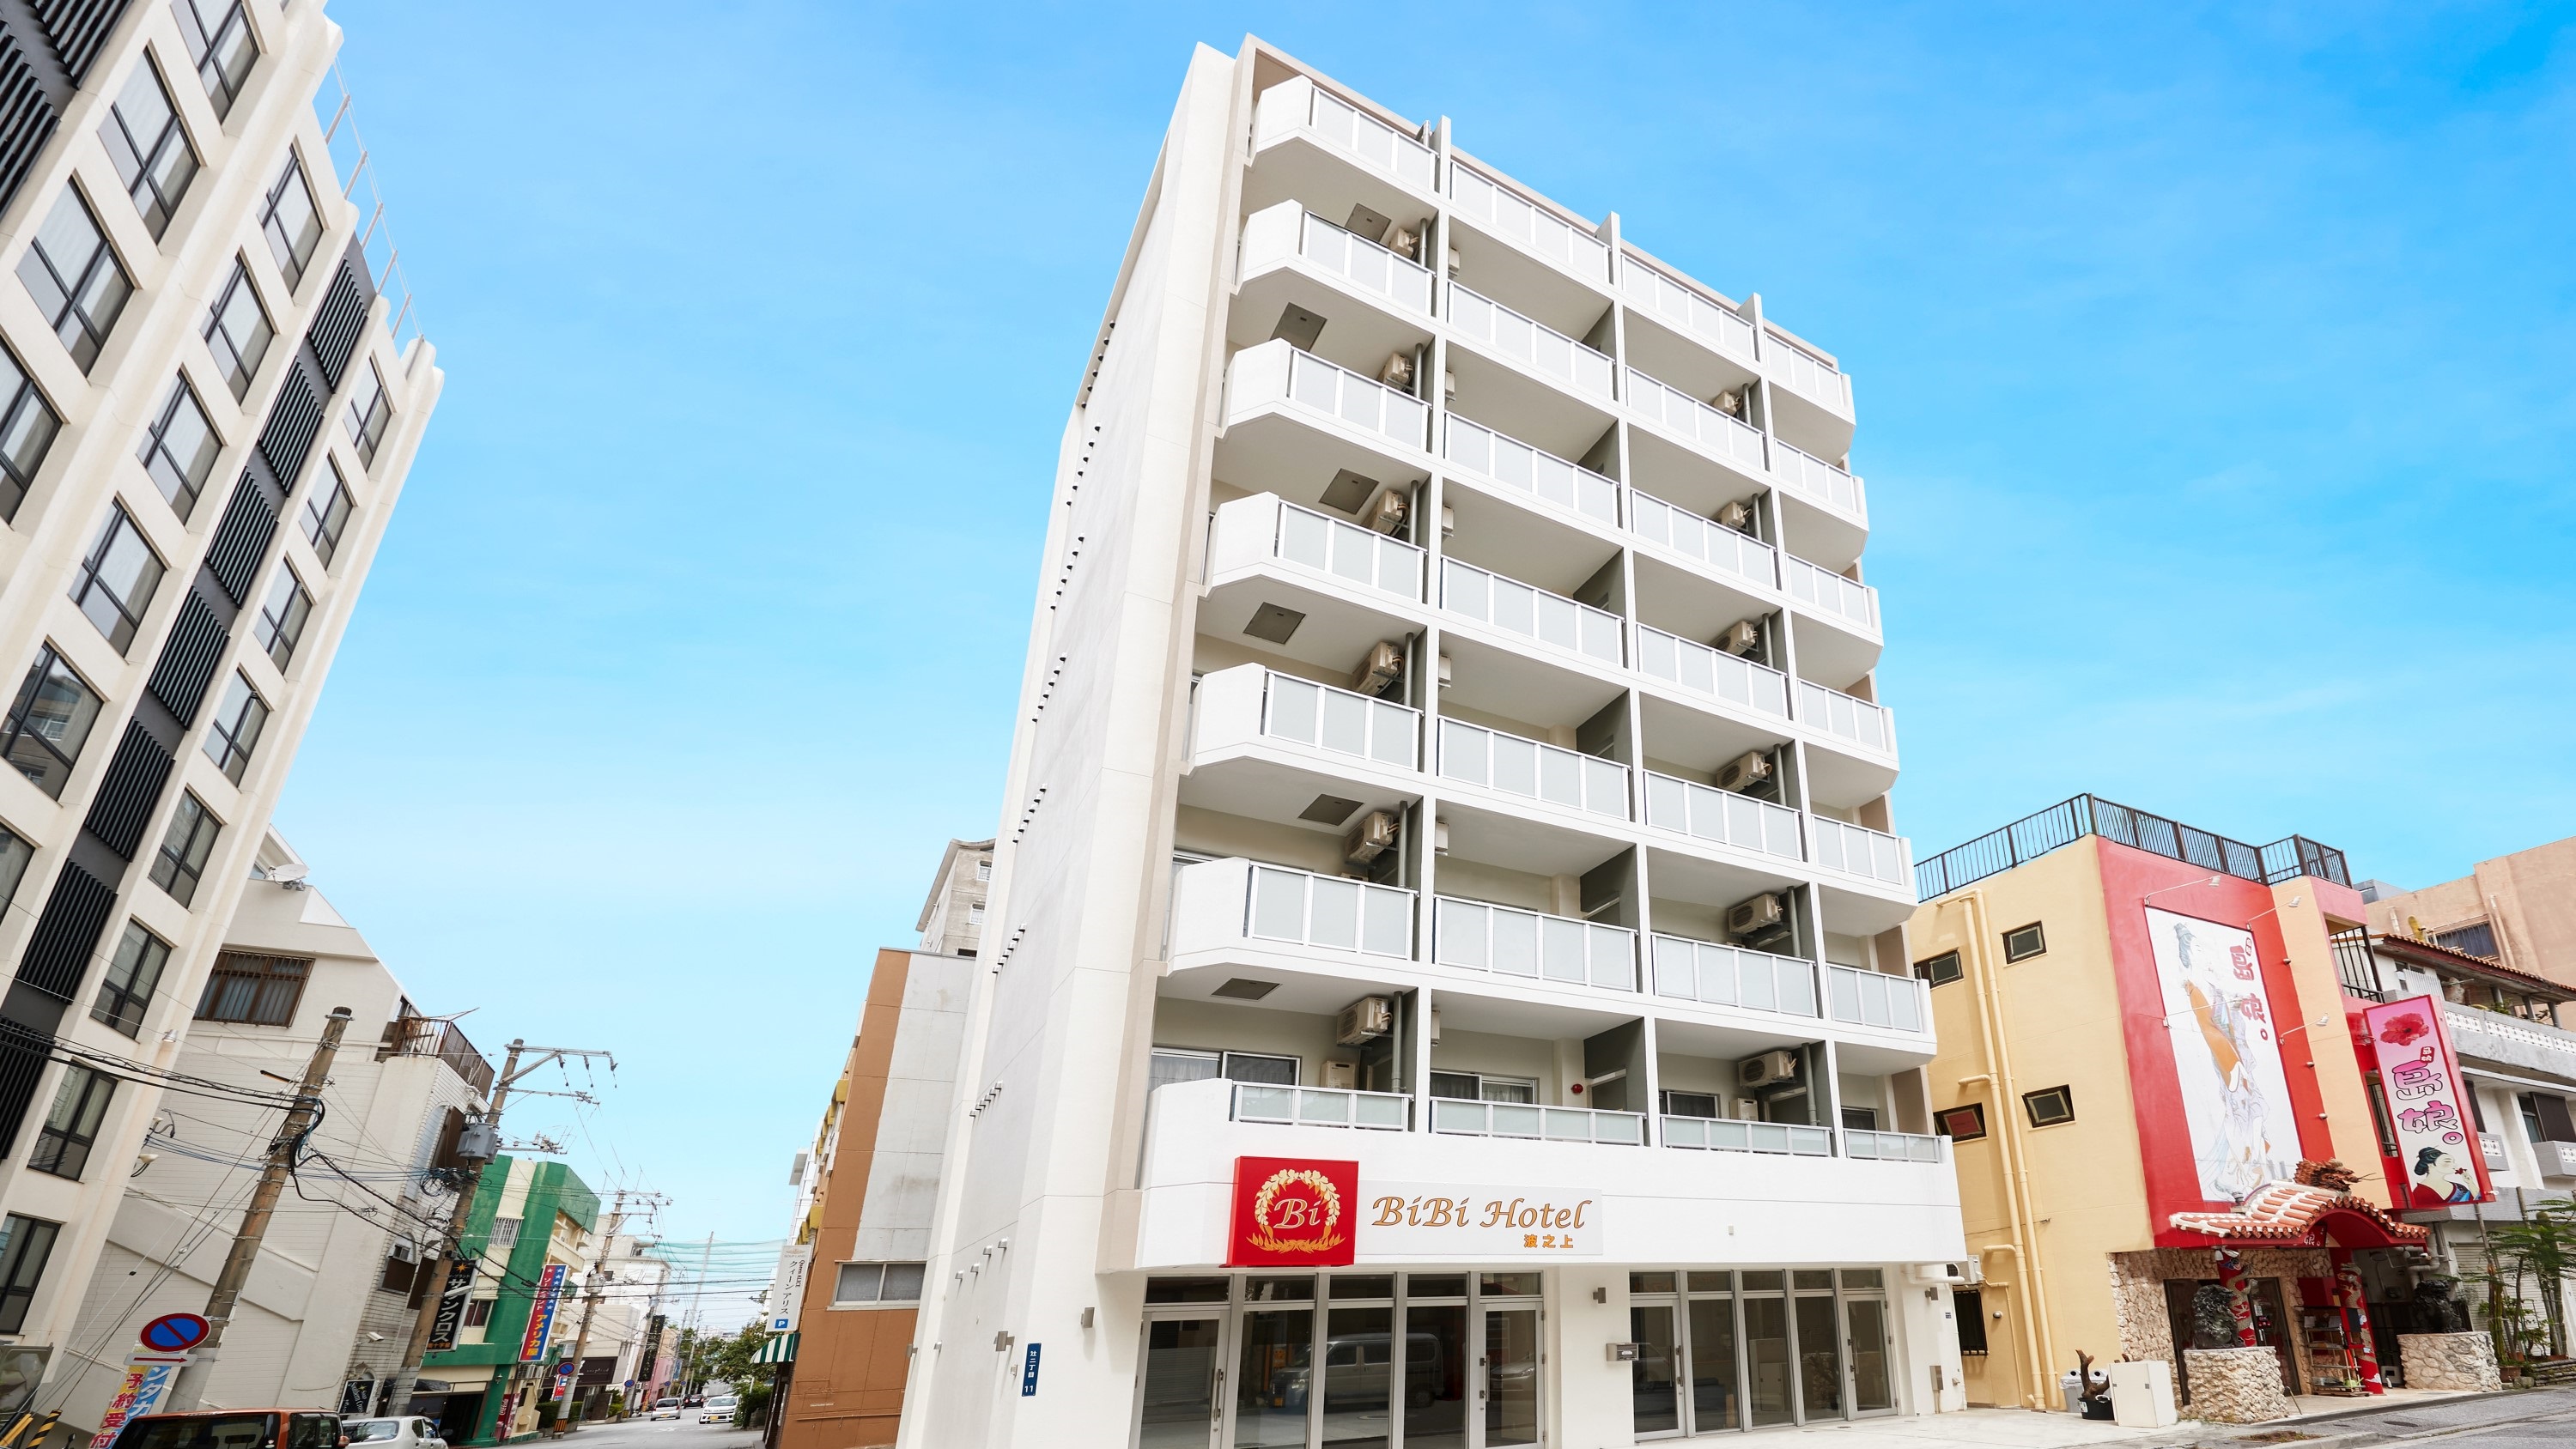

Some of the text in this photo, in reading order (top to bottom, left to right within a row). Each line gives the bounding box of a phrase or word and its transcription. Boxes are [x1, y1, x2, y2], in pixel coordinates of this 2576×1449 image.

[1273, 1197, 1321, 1229] Bi
[1371, 1195, 1593, 1230] BiBi Hotel
[1523, 1234, 1574, 1249] 波之上
[431, 1278, 467, 1343] サンクロス
[1024, 1385, 1034, 1393] 11
[89, 1373, 144, 1449] 予約受付
